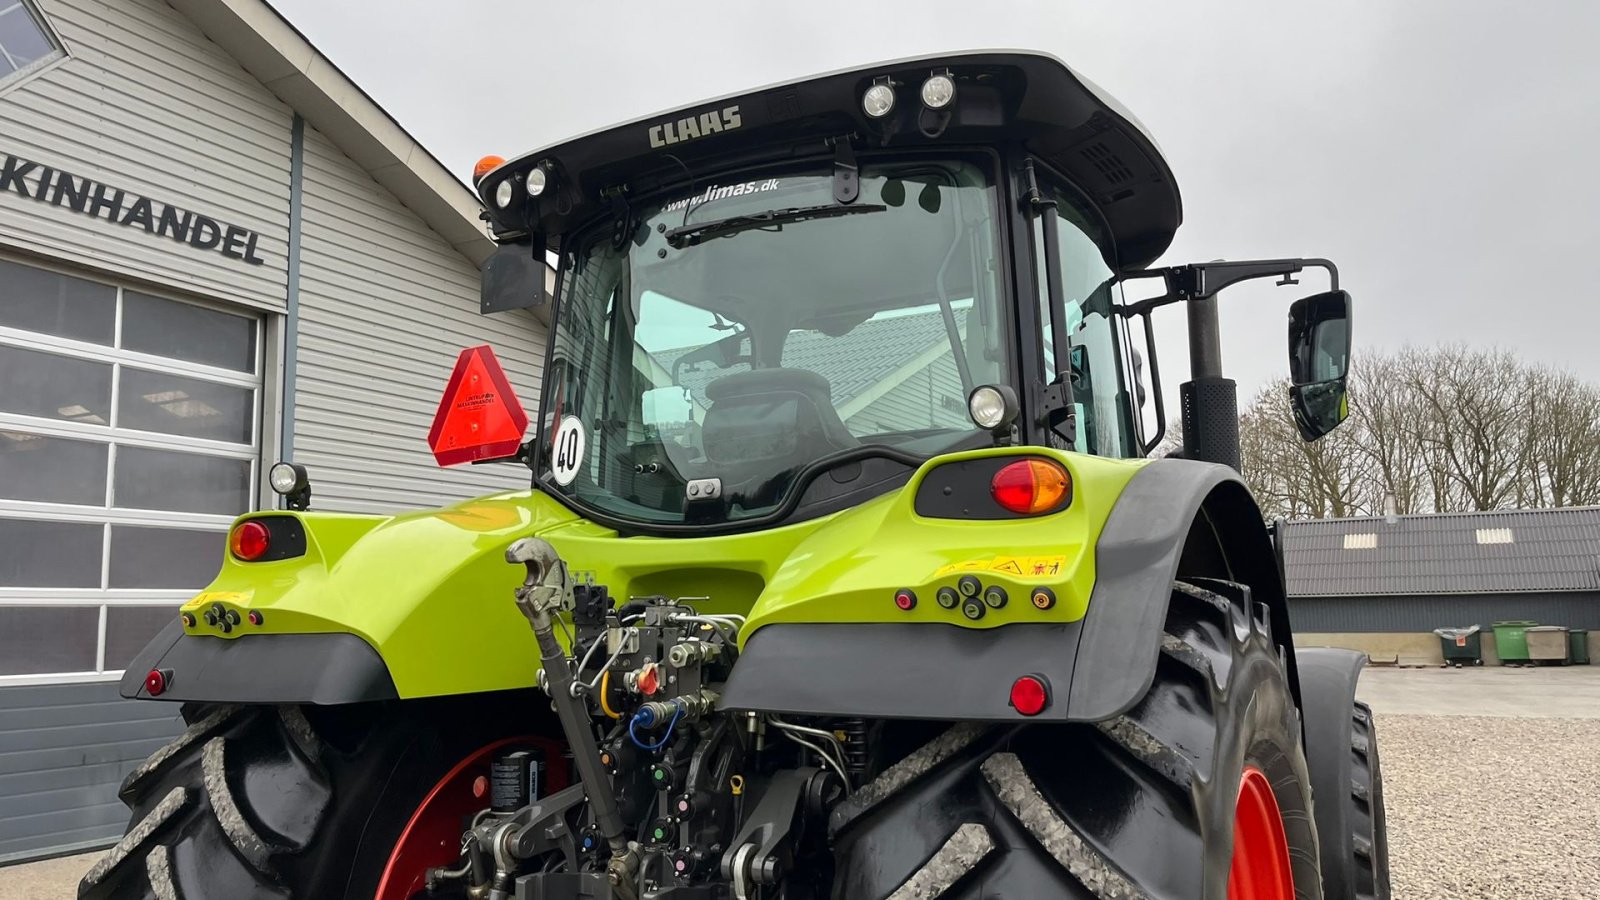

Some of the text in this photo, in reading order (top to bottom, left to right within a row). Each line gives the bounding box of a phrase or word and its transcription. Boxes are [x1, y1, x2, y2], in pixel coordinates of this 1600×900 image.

[648, 105, 742, 149] CLAAS
[0, 155, 264, 265] KINHANDEL
[666, 178, 780, 212] www.limas.dk
[557, 427, 578, 473] 40
